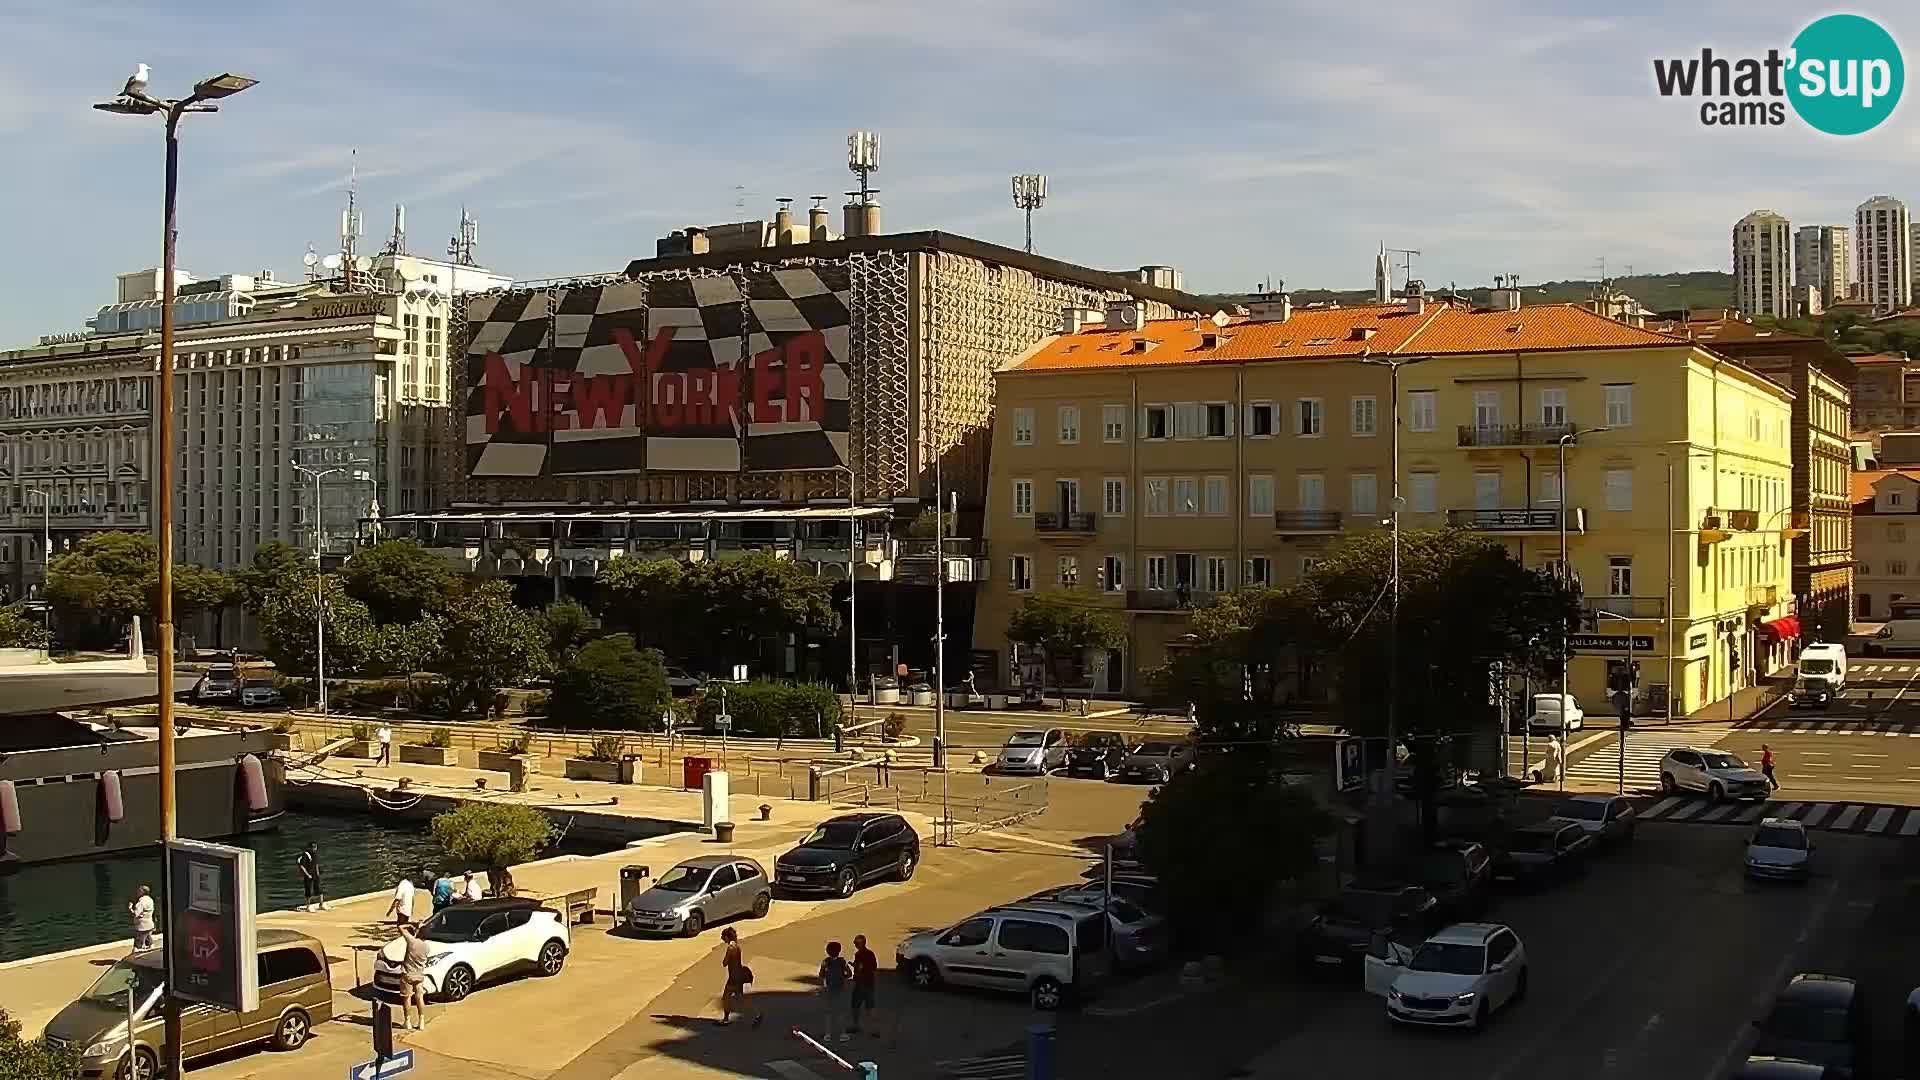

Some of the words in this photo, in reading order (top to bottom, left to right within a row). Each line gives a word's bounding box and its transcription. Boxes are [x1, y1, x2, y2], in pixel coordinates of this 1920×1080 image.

[485, 351, 626, 433] NEW
[612, 325, 825, 428] YORKER
[1569, 639, 1613, 647] JULIANA
